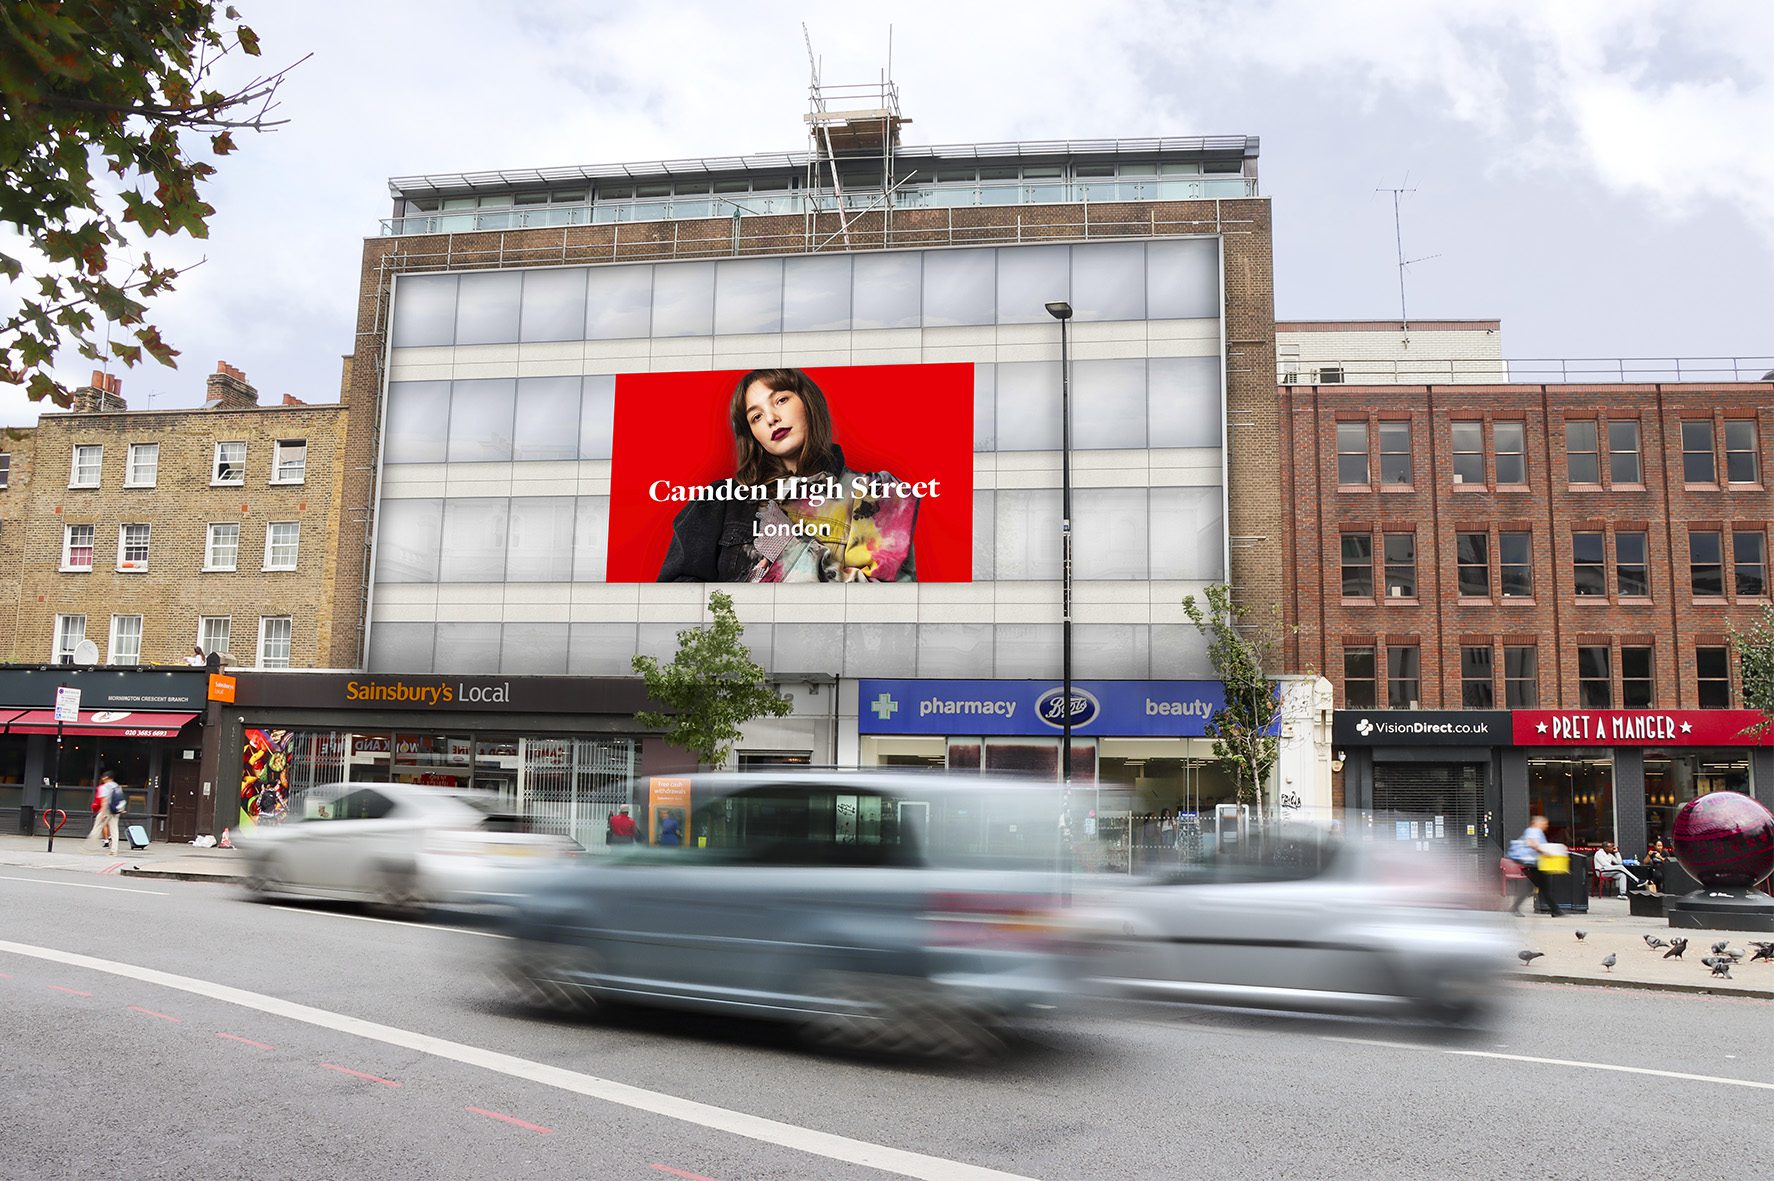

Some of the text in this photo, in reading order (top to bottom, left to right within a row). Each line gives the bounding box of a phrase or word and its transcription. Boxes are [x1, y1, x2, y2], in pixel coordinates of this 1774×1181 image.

[648, 477, 941, 508] Camden High Street
[752, 519, 831, 538] London
[346, 681, 510, 706] Sainsbury's Local
[919, 697, 1017, 719] pharmacy
[1145, 698, 1213, 720] beauty
[1375, 722, 1489, 734] VisionDirect.co.uk
[1552, 715, 1676, 739] PRET A MANGER
